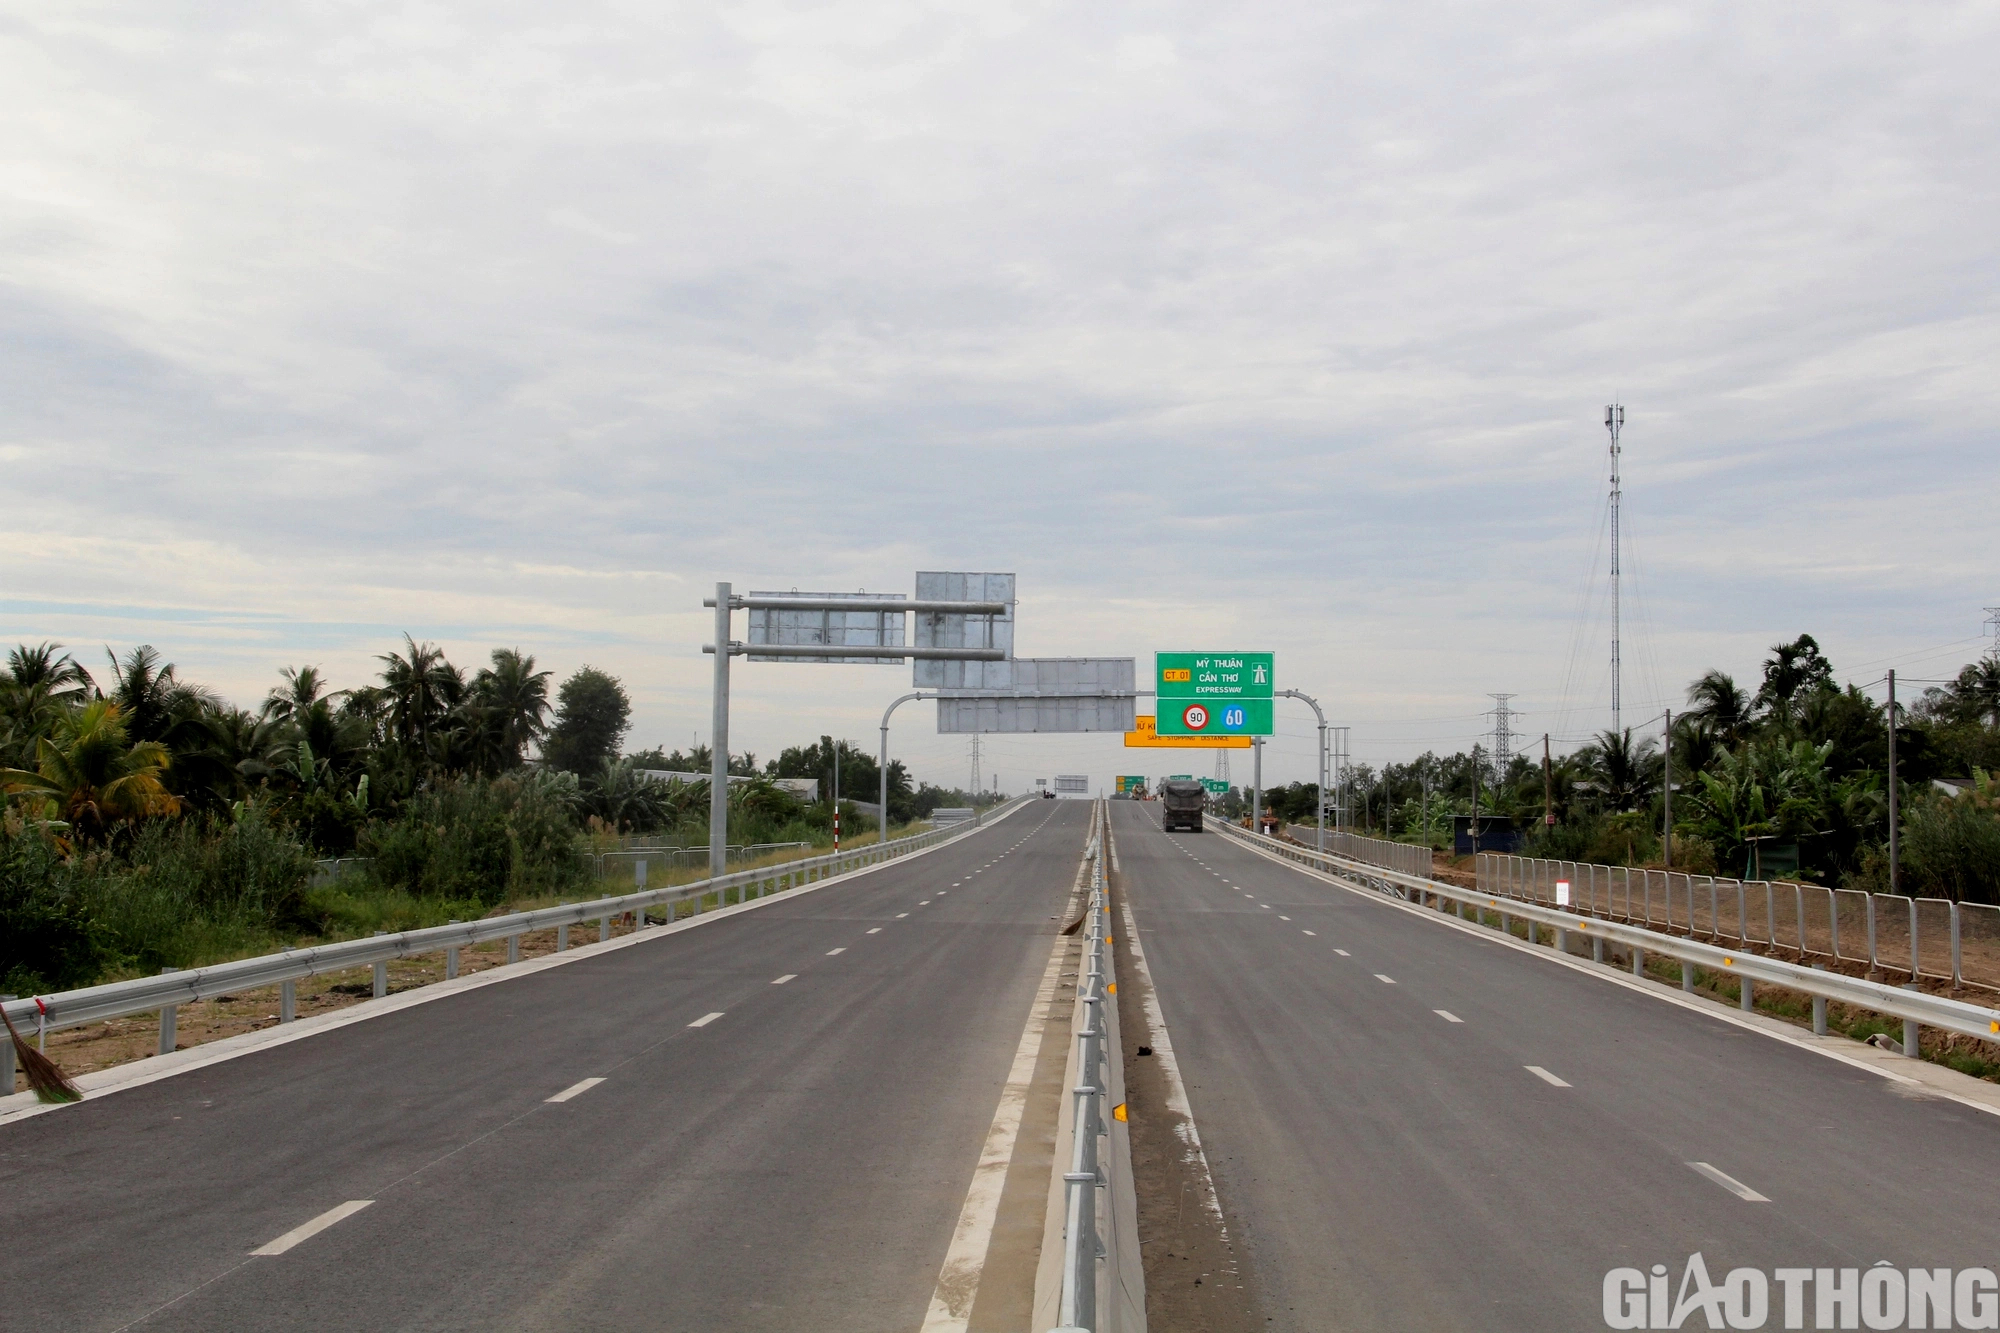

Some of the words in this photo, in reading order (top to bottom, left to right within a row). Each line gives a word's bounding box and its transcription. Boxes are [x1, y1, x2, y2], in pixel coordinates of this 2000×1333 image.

[1196, 657, 1210, 668] MỸ
[1213, 657, 1243, 670] THUẬN
[1221, 672, 1239, 683] THƠ
[1190, 712, 1203, 722] 90
[1225, 709, 1243, 726] 60
